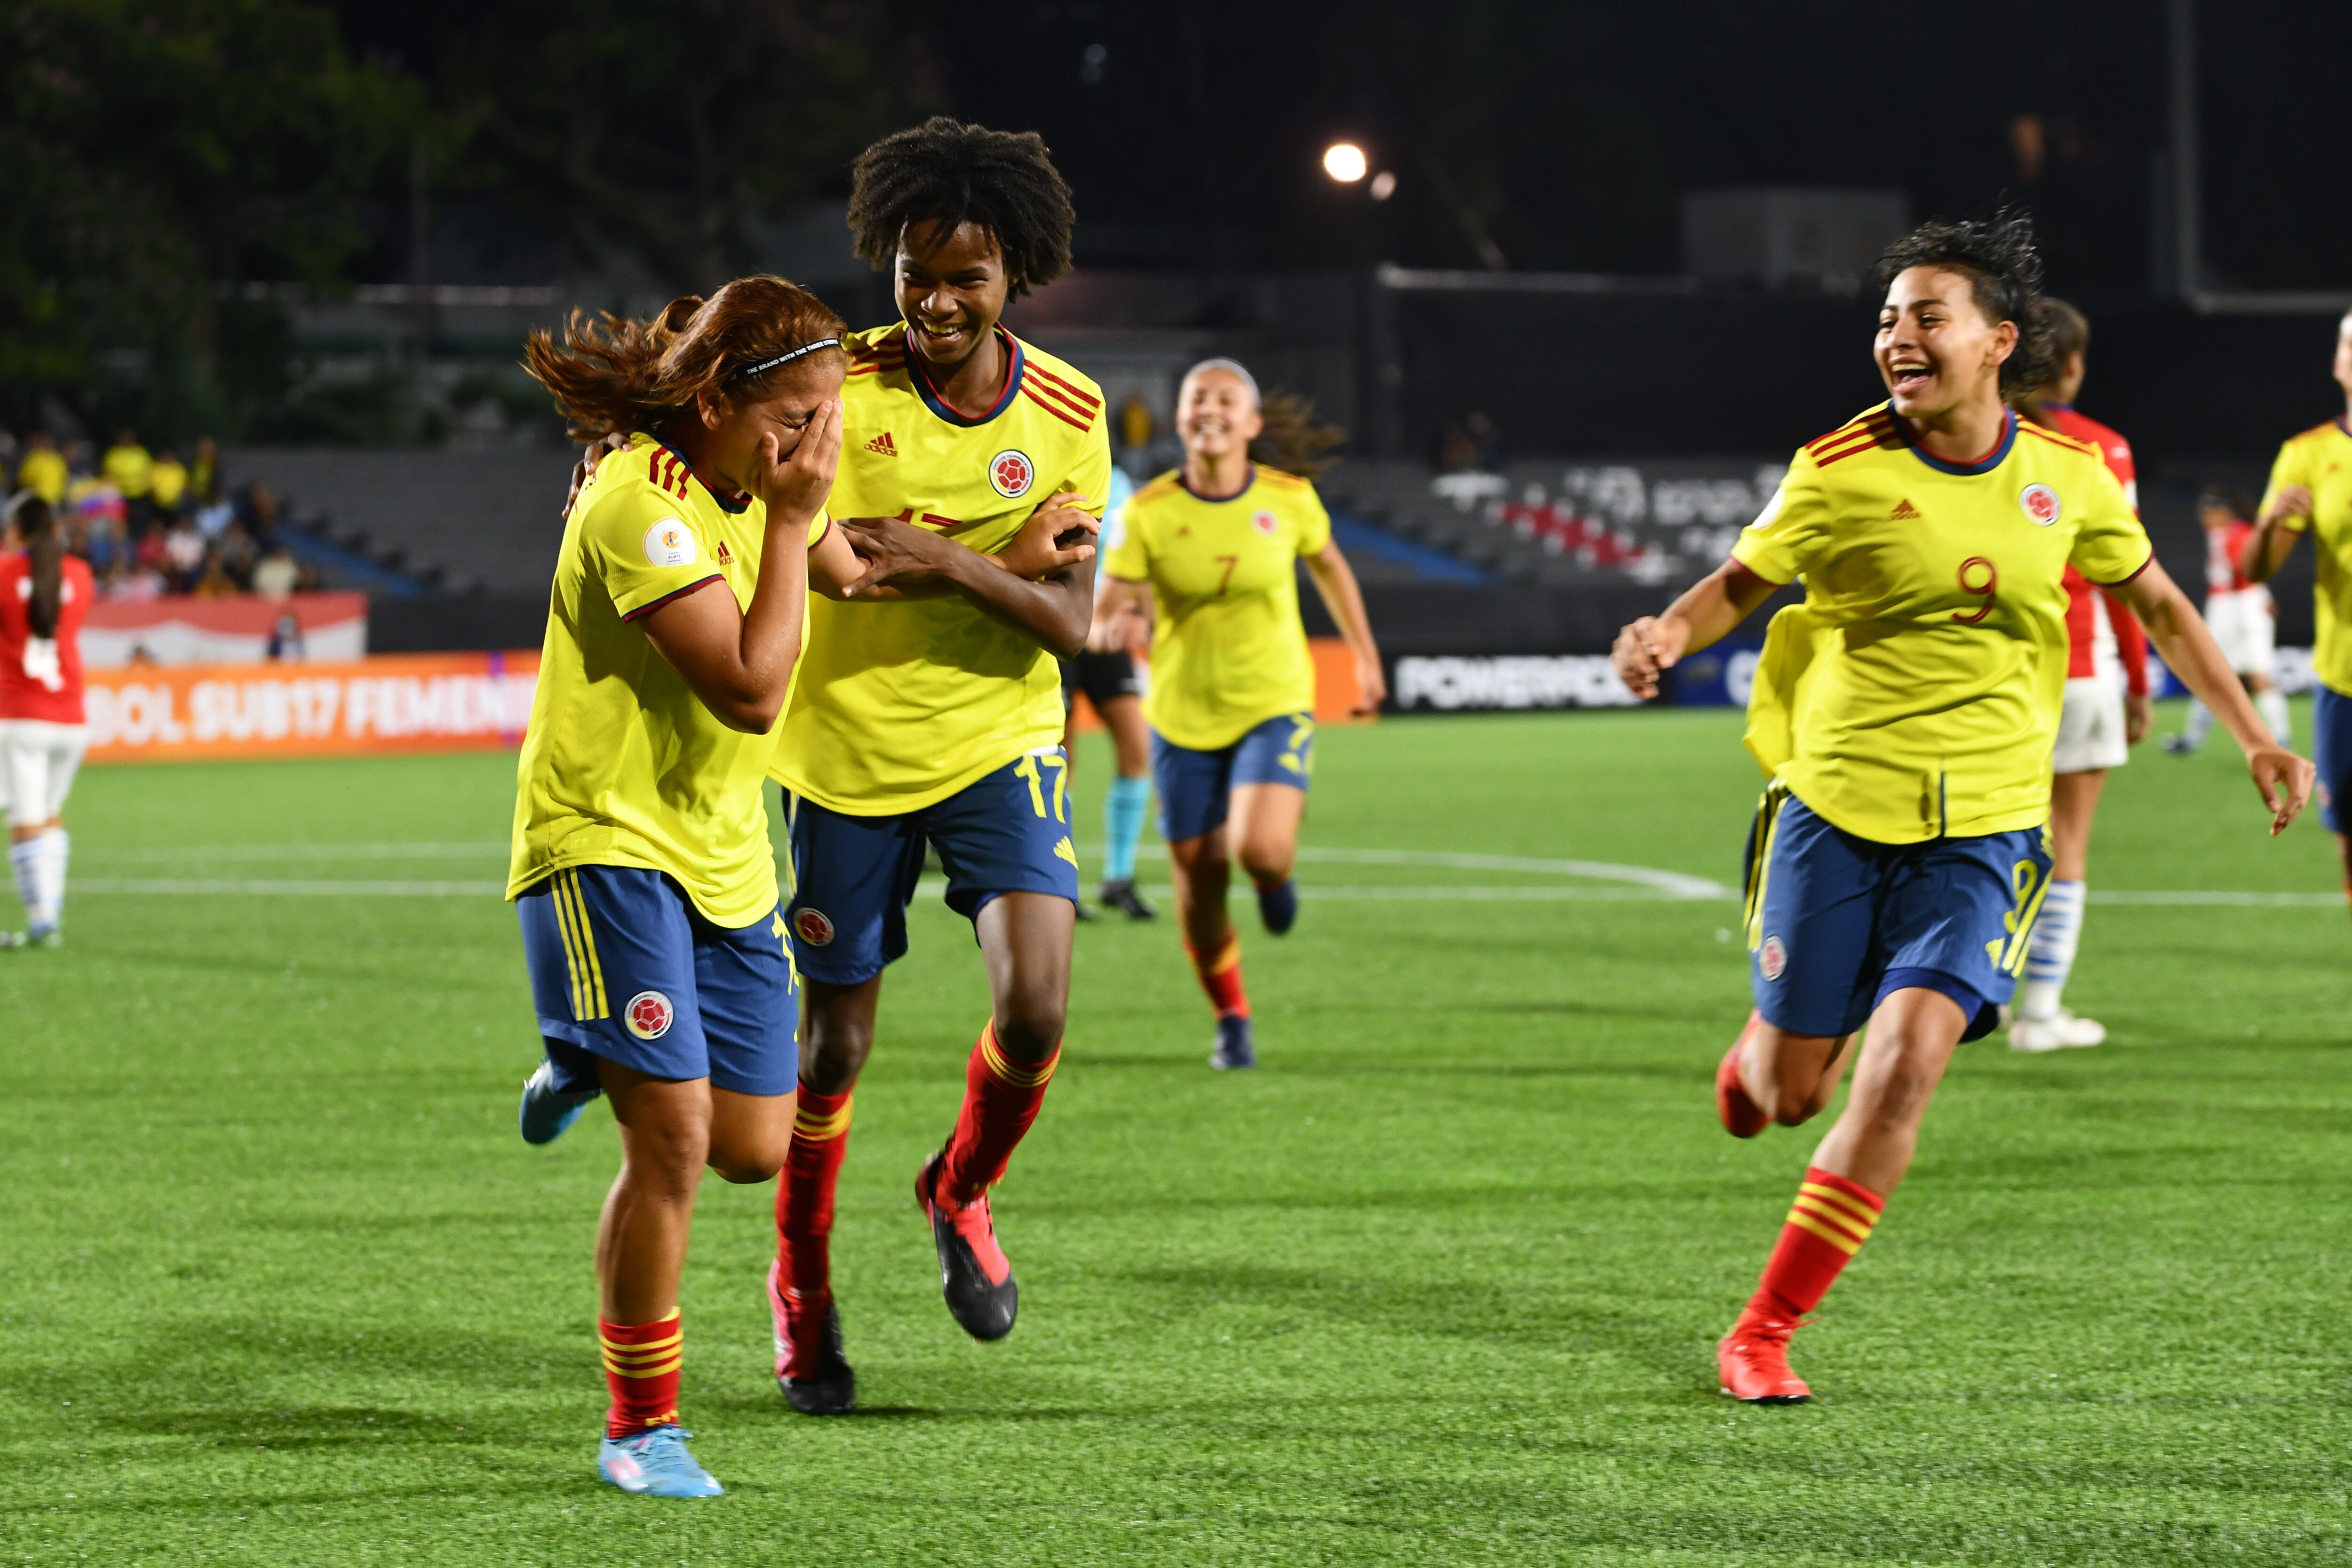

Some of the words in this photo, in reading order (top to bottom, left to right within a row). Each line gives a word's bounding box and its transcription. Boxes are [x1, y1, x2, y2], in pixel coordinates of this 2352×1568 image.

[758, 359, 779, 370] BRAND
[779, 352, 796, 362] WITH
[795, 347, 808, 356] THE
[806, 341, 825, 351] THREE
[864, 443, 898, 457] adidas
[1215, 553, 1238, 597] 7
[1951, 556, 1997, 623] 9
[192, 680, 340, 740] SUB17
[1290, 714, 1313, 750] 7
[1013, 754, 1067, 824] 17
[2003, 859, 2039, 934] 9
